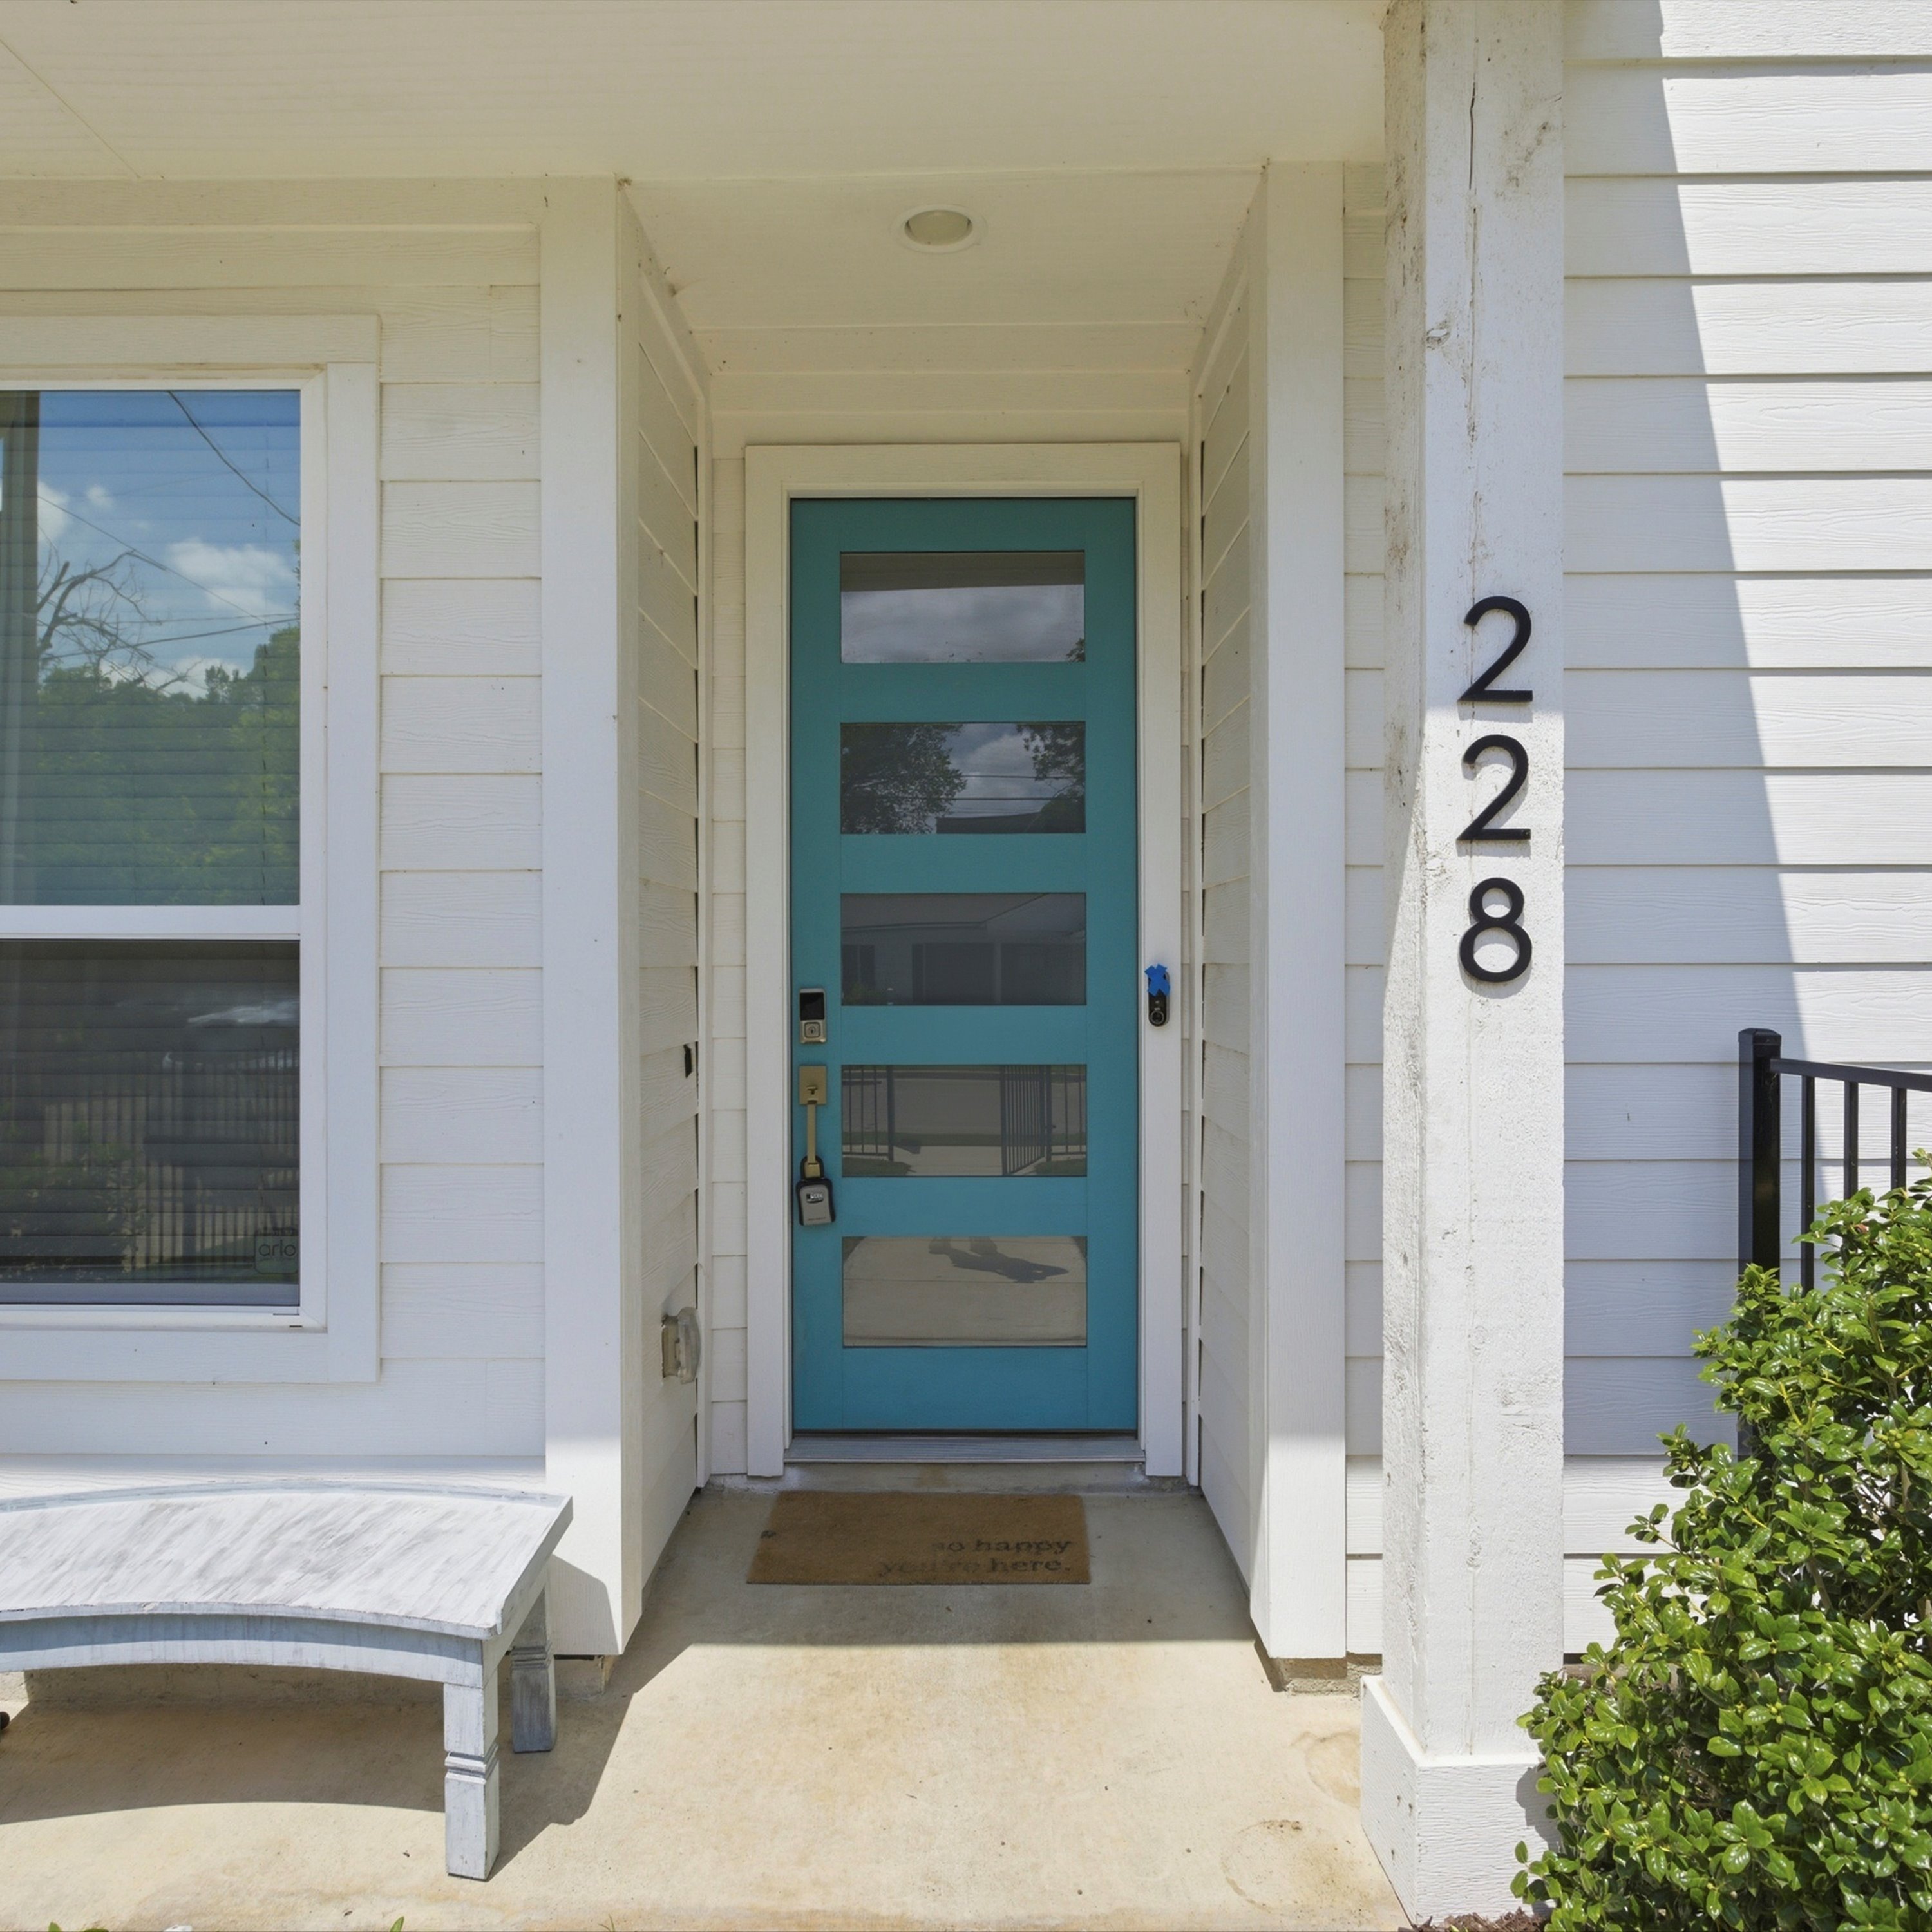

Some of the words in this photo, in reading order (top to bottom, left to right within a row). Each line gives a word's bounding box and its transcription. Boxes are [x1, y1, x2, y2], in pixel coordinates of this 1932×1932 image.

[1457, 595, 1533, 983] 228
[259, 1239, 296, 1256] arlo
[973, 1539, 1072, 1555] happy
[989, 1557, 1070, 1573] here.
